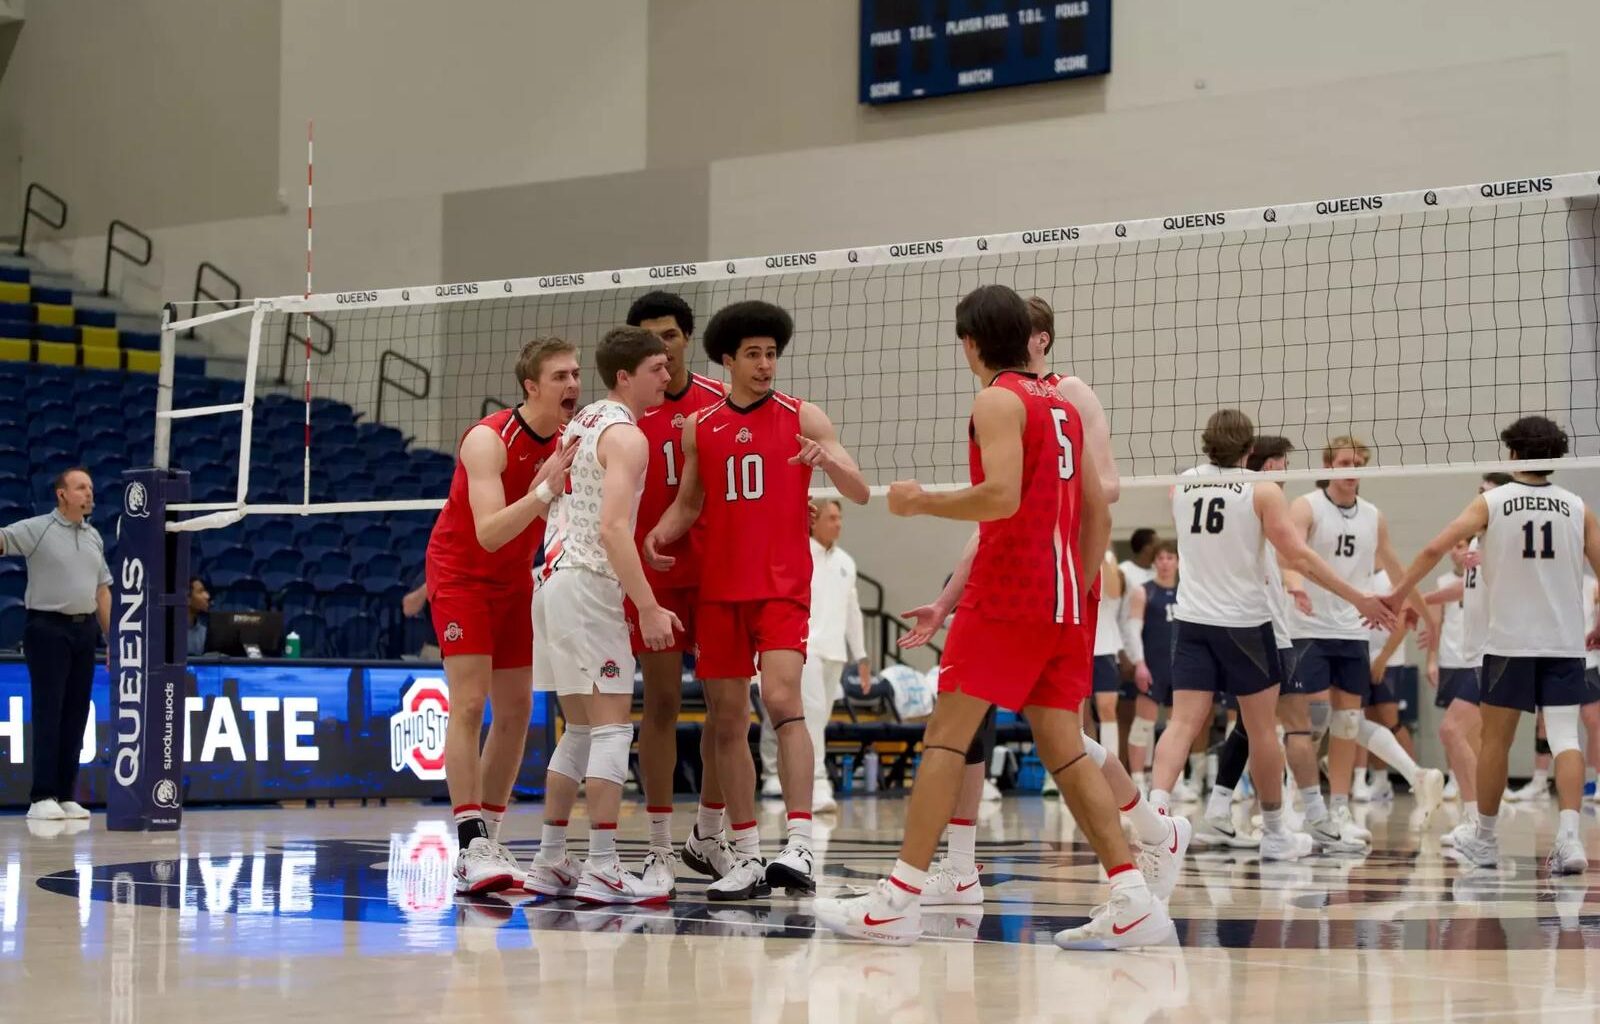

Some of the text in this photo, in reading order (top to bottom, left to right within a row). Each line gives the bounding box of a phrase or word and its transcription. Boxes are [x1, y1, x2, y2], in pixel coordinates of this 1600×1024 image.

[946, 17, 983, 35] PLAYER
[958, 68, 994, 86] MATCH
[1054, 54, 1089, 73] SCORE
[336, 178, 1553, 304] QUEENS Q QUEENS Q QUEENS Q QUEENS Q QUEENS Q QUEENS Q QUEENS Q QUEENS Q QUEENS Q QUEENS
[1049, 406, 1076, 480] 5
[725, 453, 764, 501] 10
[1190, 497, 1226, 534] 16
[1503, 496, 1570, 518] QUEENS
[1335, 534, 1356, 558] 15
[1522, 520, 1555, 559] 11
[114, 556, 144, 787] QUEENS
[162, 682, 174, 770] sports imports
[183, 697, 320, 762] TATE
